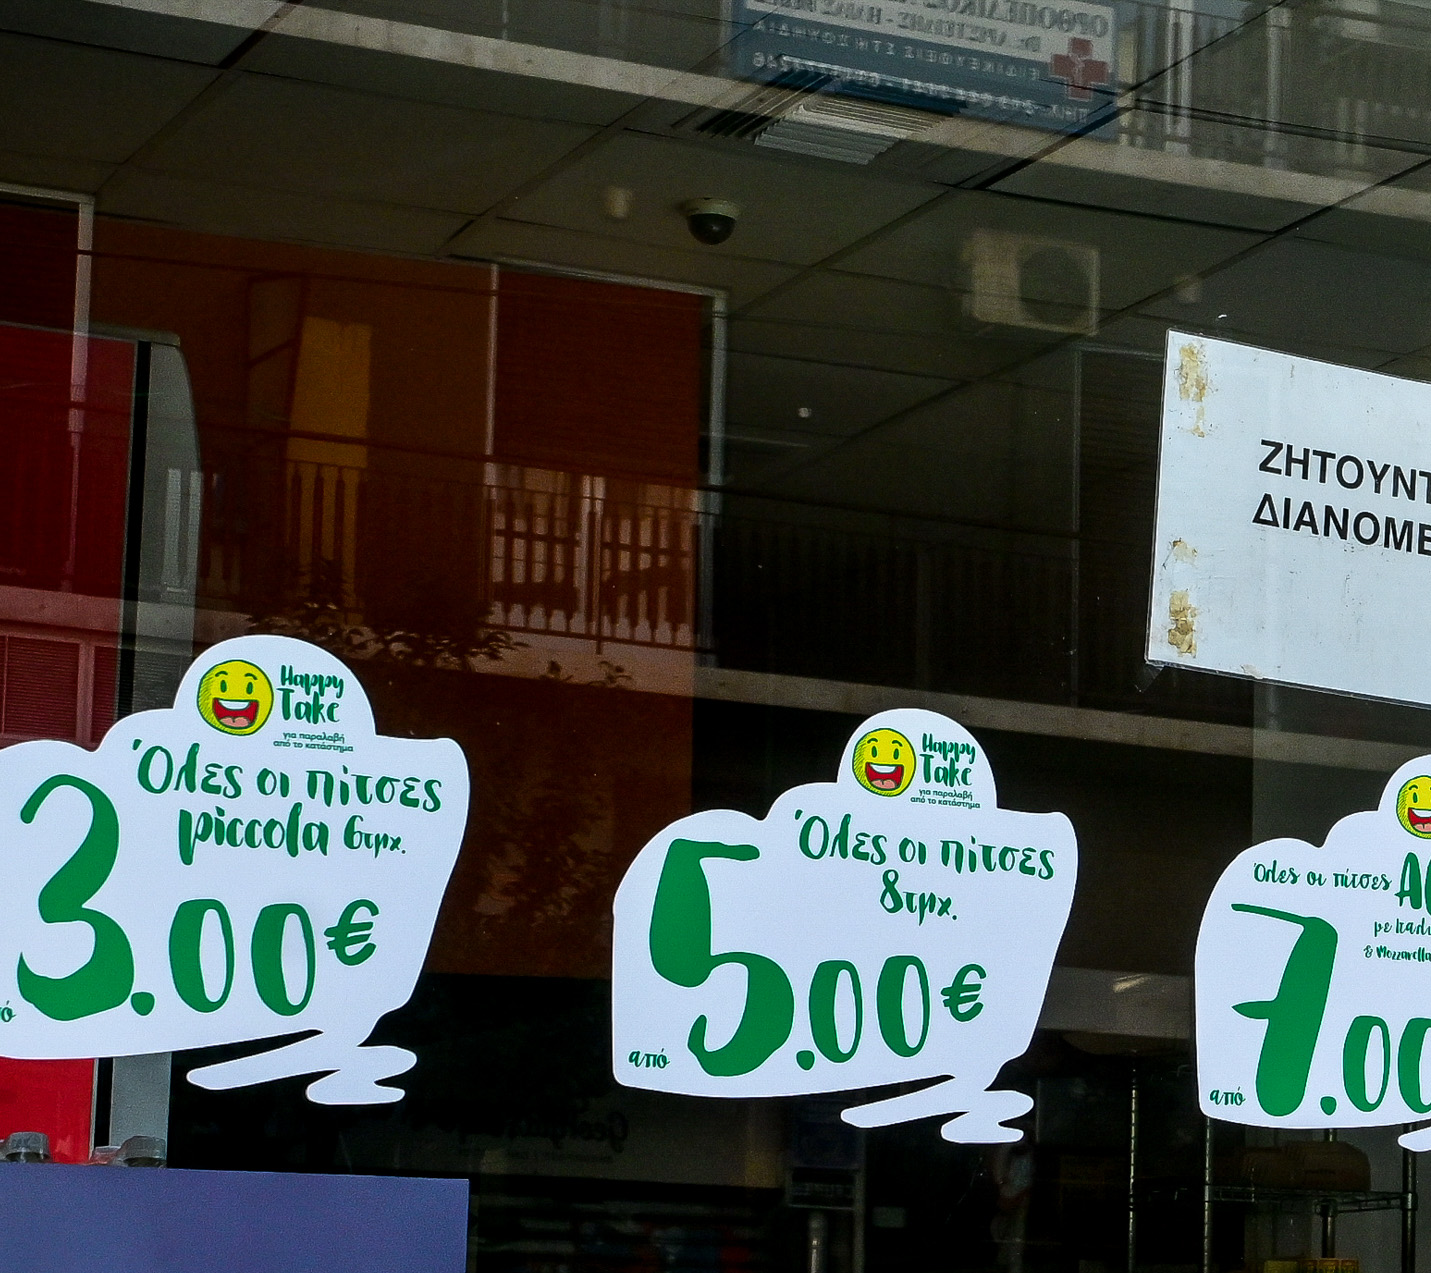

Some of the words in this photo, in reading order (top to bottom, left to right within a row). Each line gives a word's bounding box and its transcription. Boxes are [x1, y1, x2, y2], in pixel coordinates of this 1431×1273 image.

[281, 664, 344, 699] Happy
[276, 688, 340, 724] Take
[283, 732, 297, 740] για
[299, 731, 345, 744] παραλαβή
[921, 732, 976, 765] Happy
[919, 753, 973, 787] Take
[257, 767, 290, 798] οι
[306, 767, 443, 813] πίτσες
[932, 789, 973, 802] παραλαβή
[178, 803, 329, 865] piccola
[899, 836, 926, 866] οι
[940, 836, 1055, 880] πίτσες
[1307, 873, 1327, 888] οι
[1332, 869, 1393, 892] πίτσες
[1373, 919, 1393, 938] με
[1376, 945, 1431, 963] Mozzarella
[627, 1048, 671, 1070] από
[1209, 1086, 1246, 1107] από
